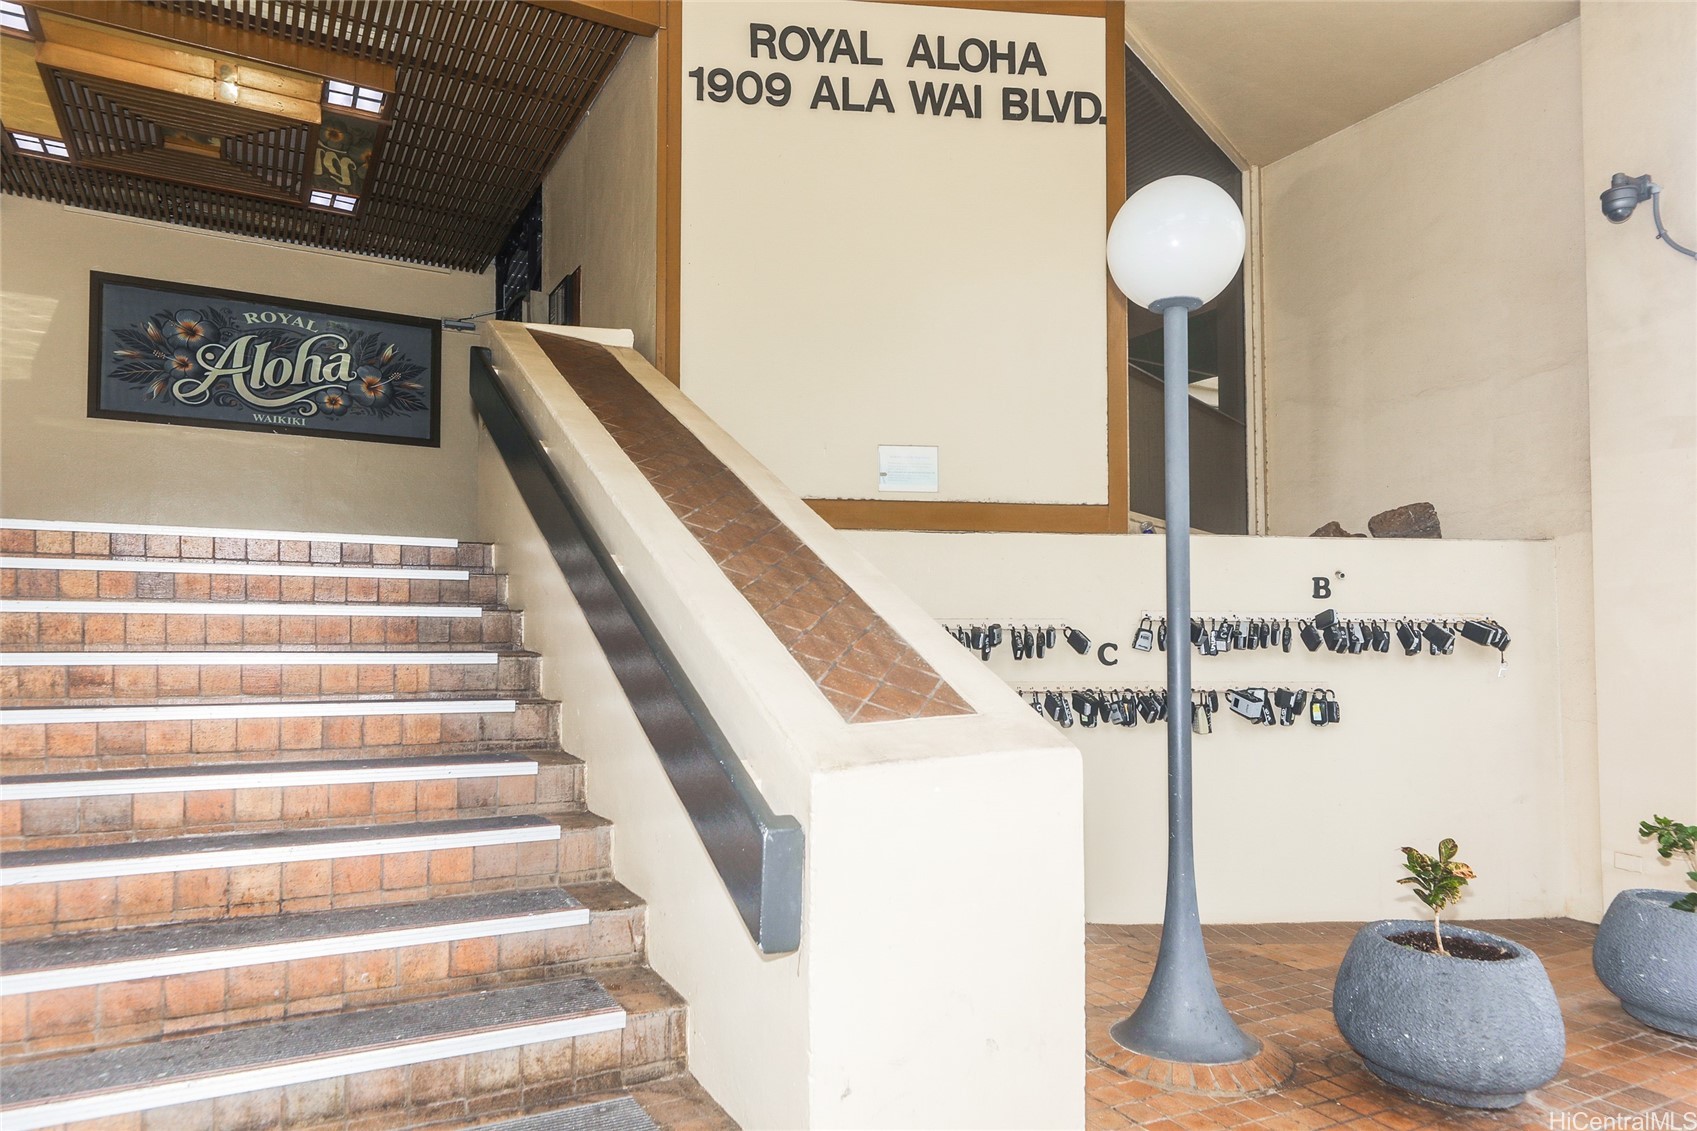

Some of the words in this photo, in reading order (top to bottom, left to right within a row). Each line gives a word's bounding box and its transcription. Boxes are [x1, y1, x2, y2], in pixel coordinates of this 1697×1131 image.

[750, 23, 883, 65] ROYAL
[906, 34, 1047, 76] ALOHA
[689, 66, 791, 107] 1909
[810, 75, 895, 113] ALA
[909, 80, 982, 118] WAI
[1002, 87, 1107, 124] BLVD.
[243, 311, 319, 333] ROYAL
[172, 333, 357, 416] Aloha
[252, 413, 306, 426] WAIKIKI
[1312, 576, 1332, 599] B
[1097, 642, 1118, 666] C
